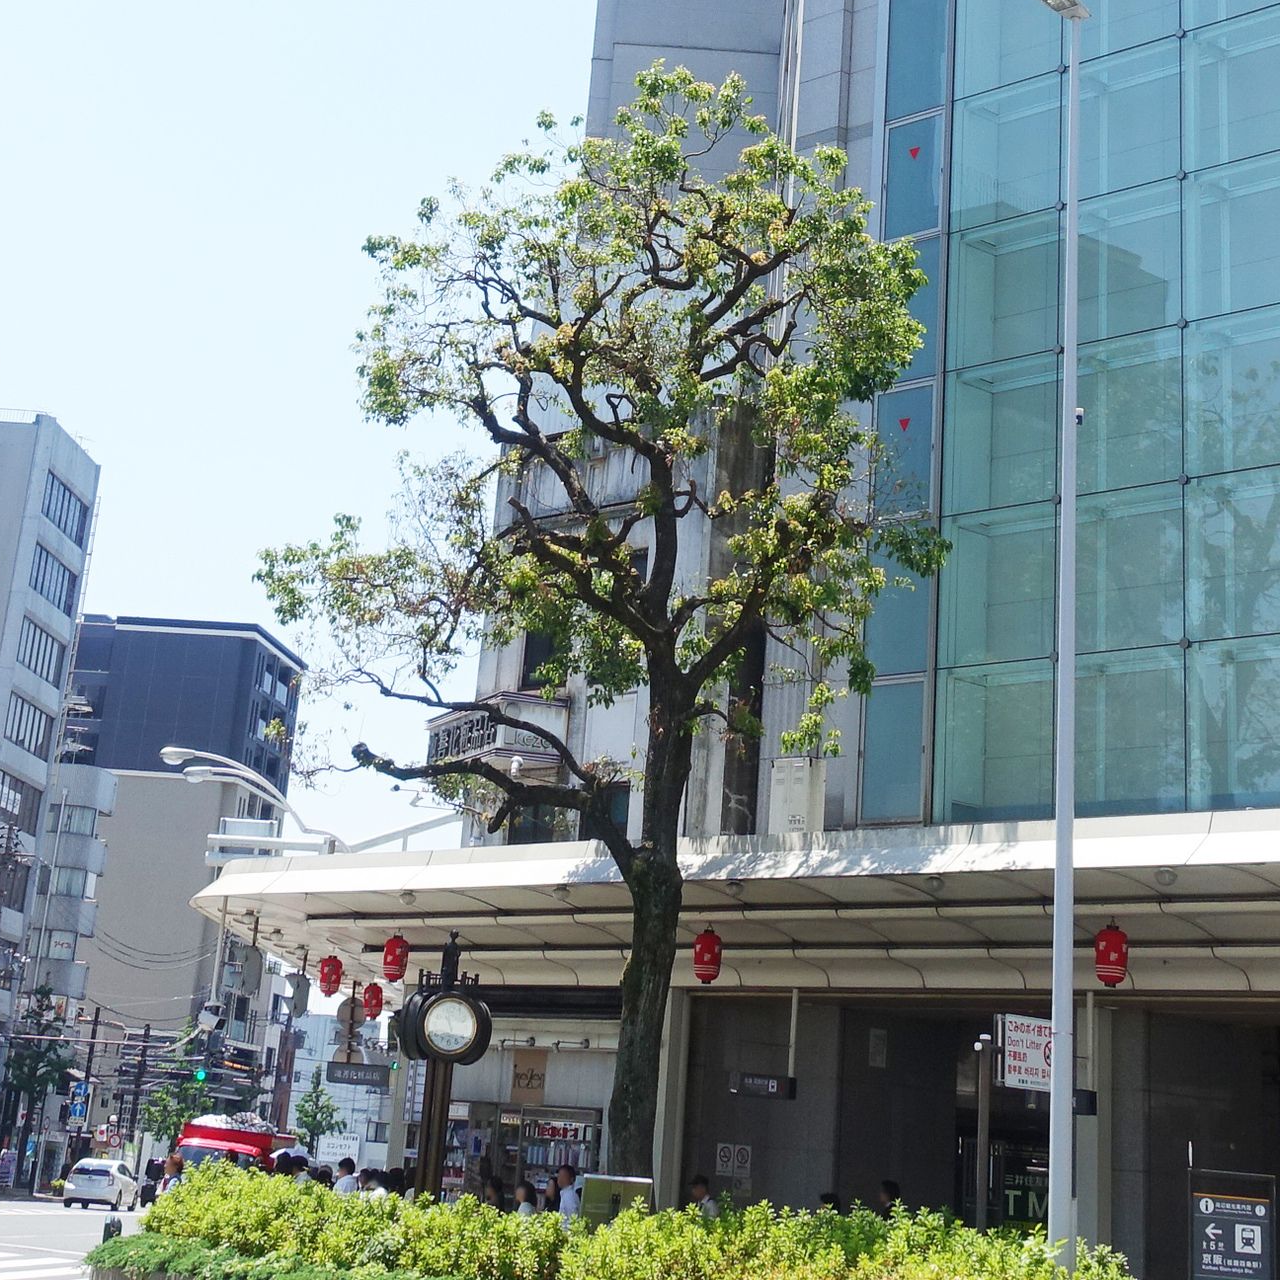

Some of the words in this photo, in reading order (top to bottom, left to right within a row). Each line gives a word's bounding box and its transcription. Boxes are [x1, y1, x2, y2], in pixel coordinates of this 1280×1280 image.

[1007, 1036, 1024, 1049] Don't
[1025, 1038, 1043, 1051] Litter
[1209, 1240, 1217, 1250] 5
